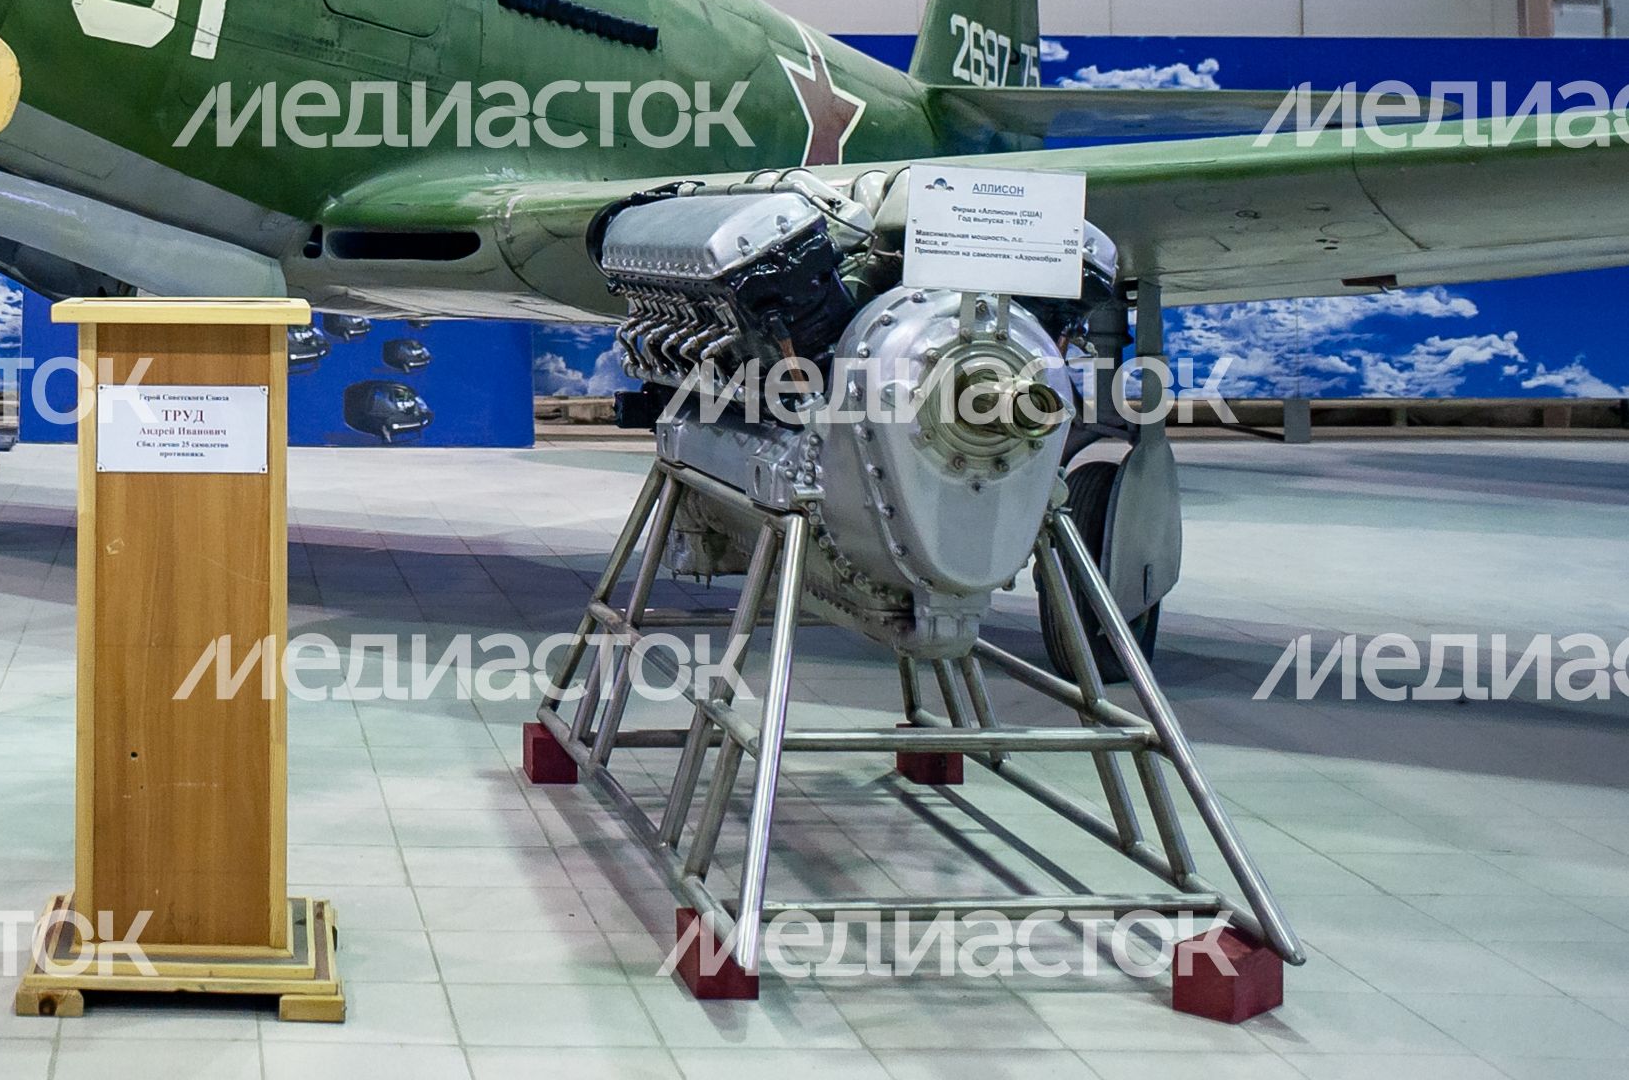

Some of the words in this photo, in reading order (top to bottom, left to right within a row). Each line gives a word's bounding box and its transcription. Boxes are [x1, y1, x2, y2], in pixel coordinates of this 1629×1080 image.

[950, 13, 1011, 88] 2697
[972, 183, 1025, 195] АЛЛИСОН
[952, 205, 976, 214] Фирма
[1019, 210, 1043, 220] (США)
[958, 214, 972, 223] Год
[973, 217, 1004, 225] выпуска
[1012, 218, 1028, 226] 1937
[915, 229, 970, 239] Максимальная
[914, 246, 960, 256] Применялся
[139, 394, 161, 402] Герой
[205, 394, 230, 402] Союза
[161, 409, 205, 424] ТРУД
[139, 427, 175, 437] Андрей
[178, 427, 227, 436] Иванович
[181, 440, 190, 448] 25
